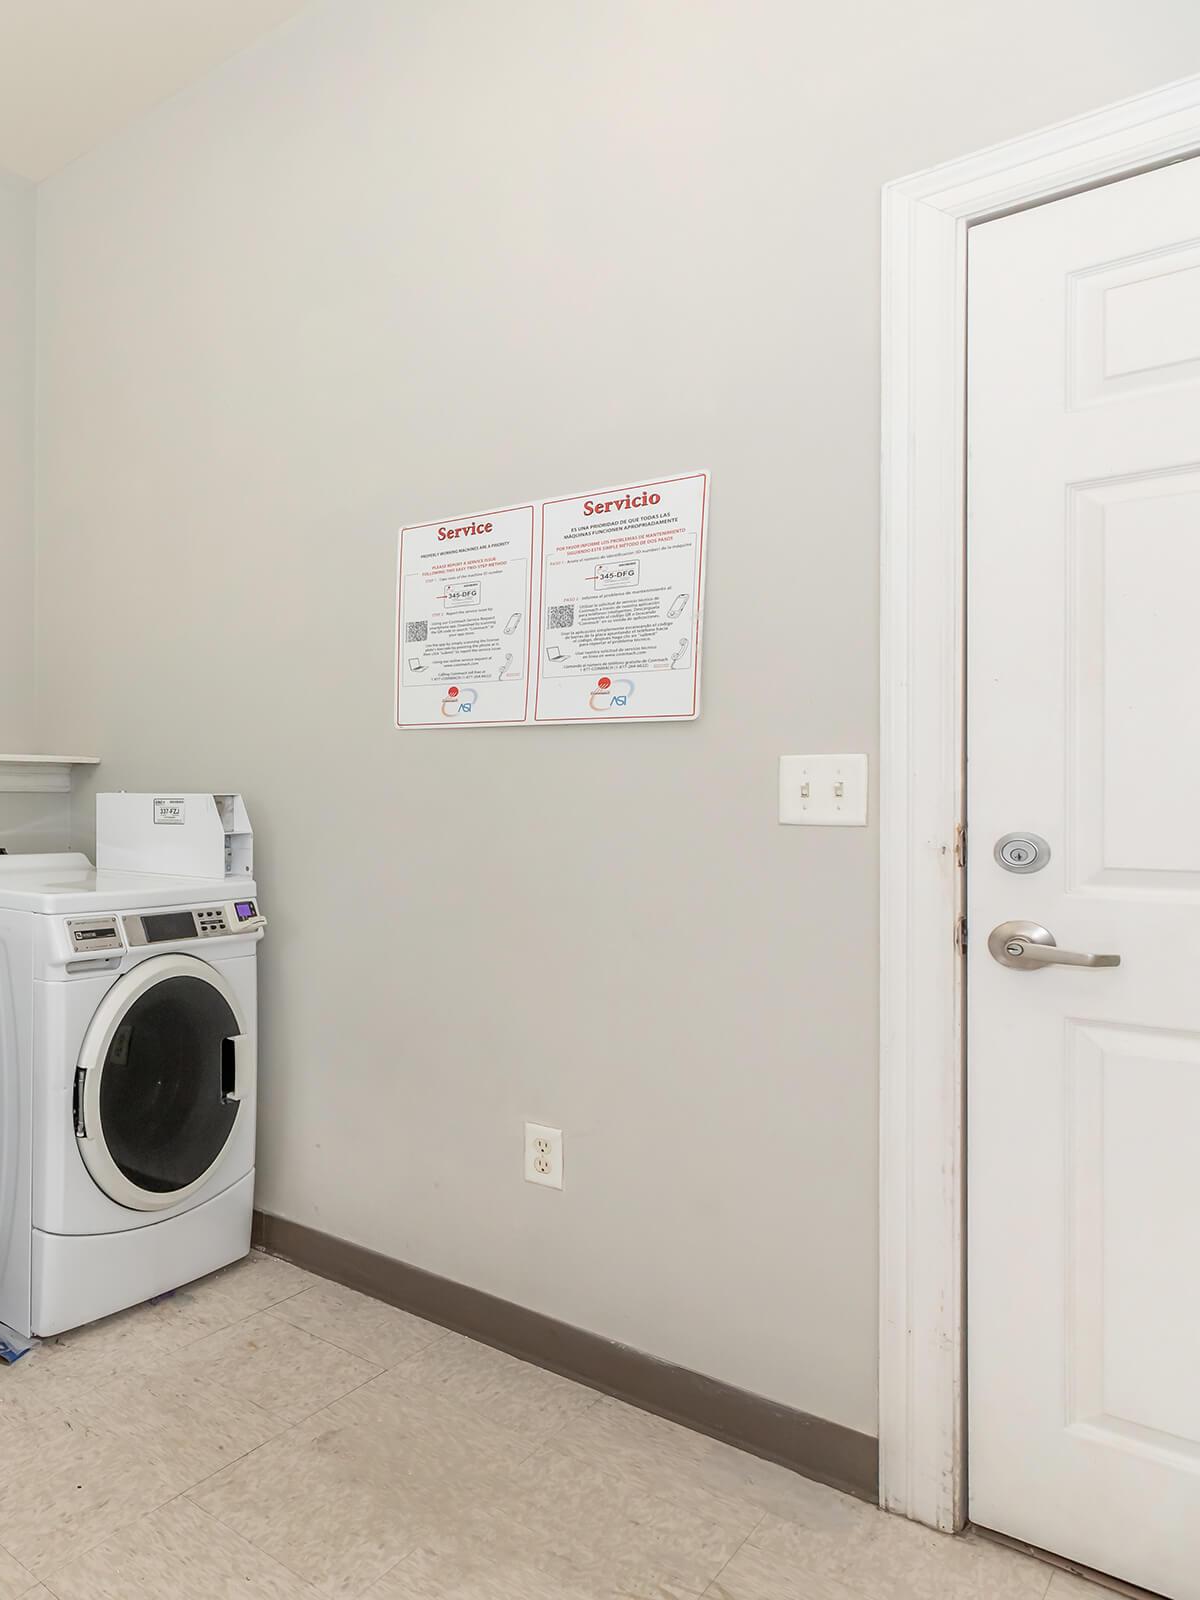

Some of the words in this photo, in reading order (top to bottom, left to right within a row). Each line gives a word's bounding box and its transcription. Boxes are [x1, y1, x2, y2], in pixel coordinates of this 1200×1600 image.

[583, 491, 661, 516] Servicio
[590, 521, 619, 529] PRIORIDAD
[437, 522, 493, 541] Service
[592, 526, 623, 535] FUNCIONEN
[600, 569, 635, 581] 345-DFG
[448, 590, 477, 599] 345-DFG
